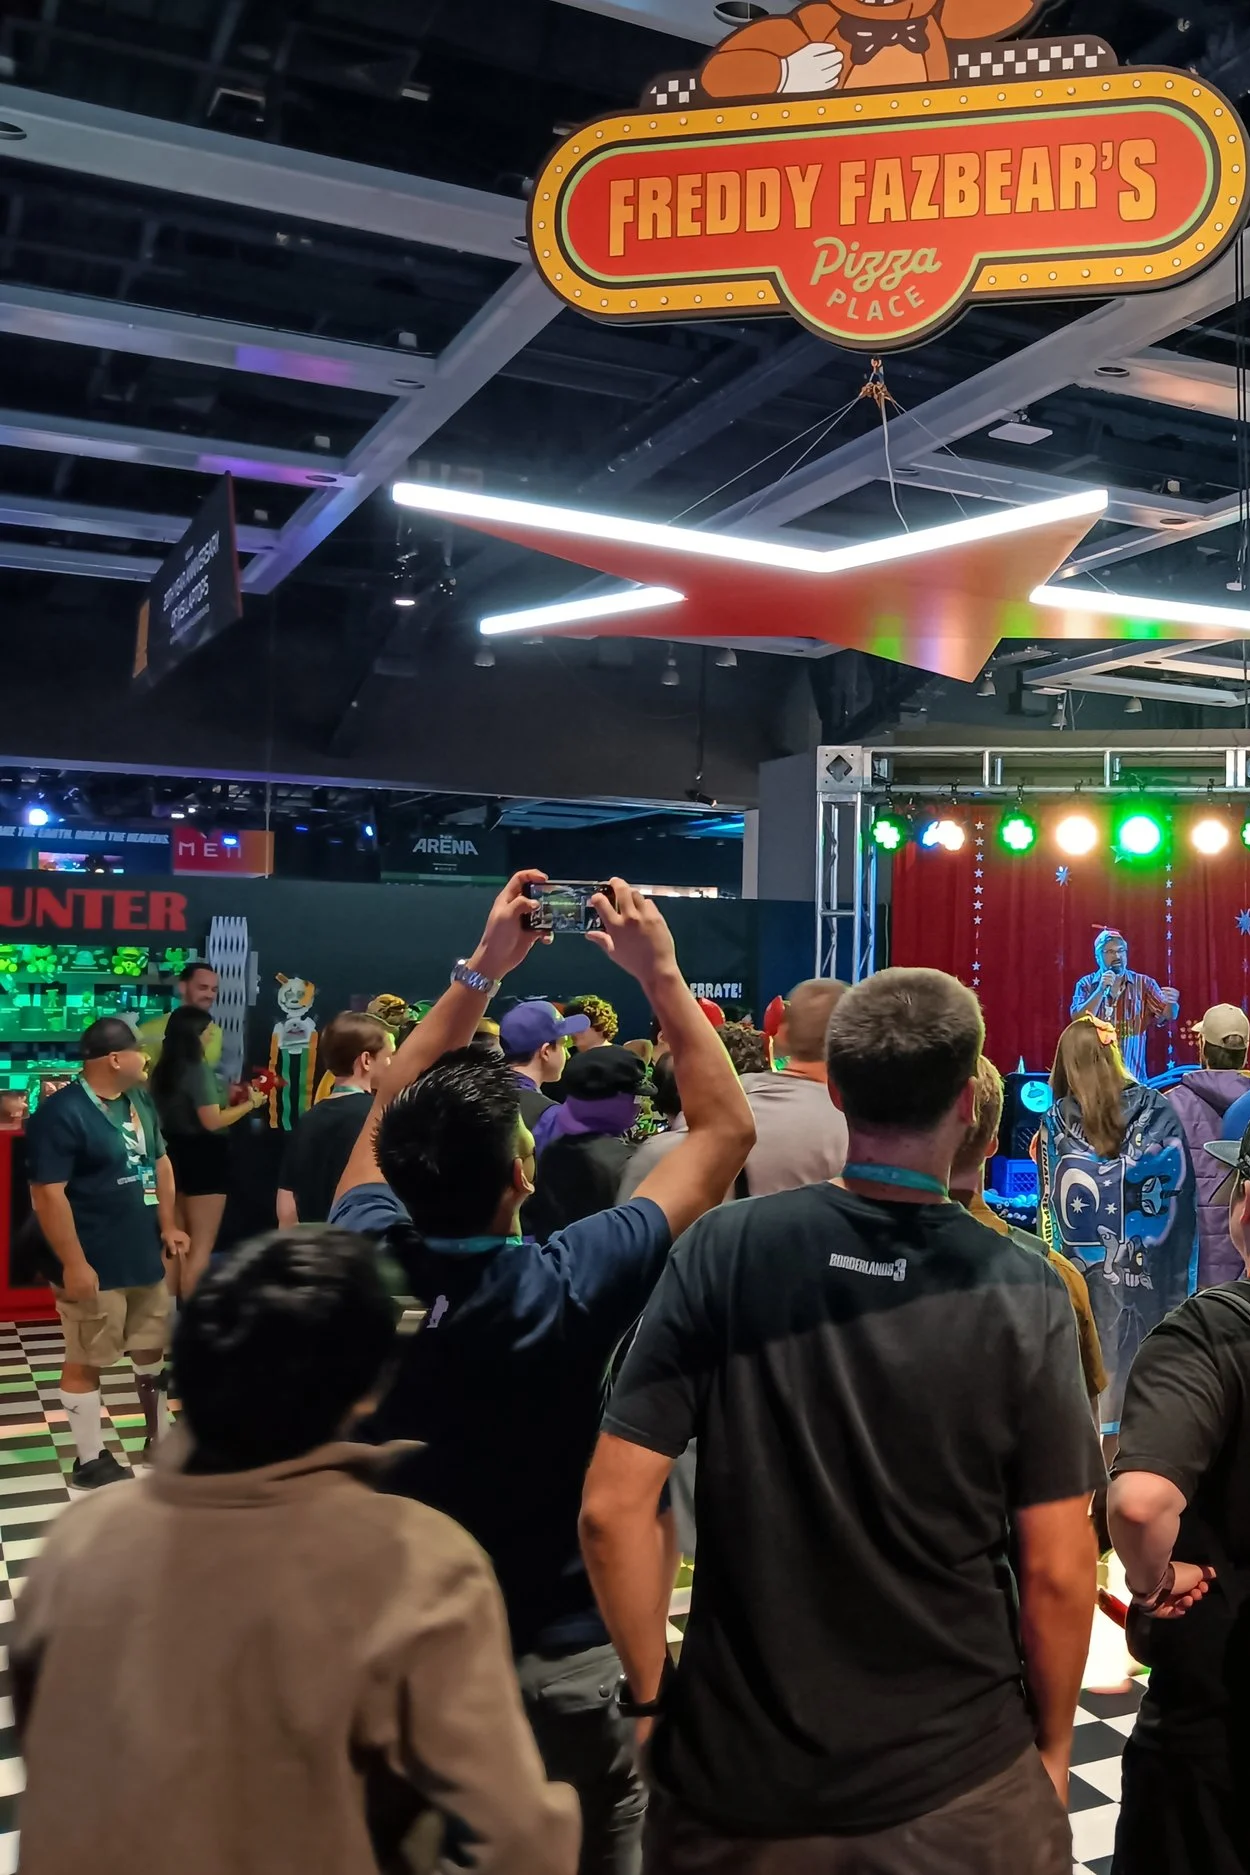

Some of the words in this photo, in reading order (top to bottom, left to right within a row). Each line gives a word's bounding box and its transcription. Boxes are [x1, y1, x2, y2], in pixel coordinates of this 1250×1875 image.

[609, 163, 823, 257] FREDDY
[838, 138, 1157, 226] FAZBEAR'S
[811, 236, 942, 293] Pizza
[826, 285, 925, 321] PLACE
[412, 838, 479, 855] ARENA
[0, 886, 187, 931] UNTER
[689, 982, 742, 999] EBRATE!
[829, 1253, 894, 1277] BORDERLANDS
[893, 1258, 907, 1281] 3
